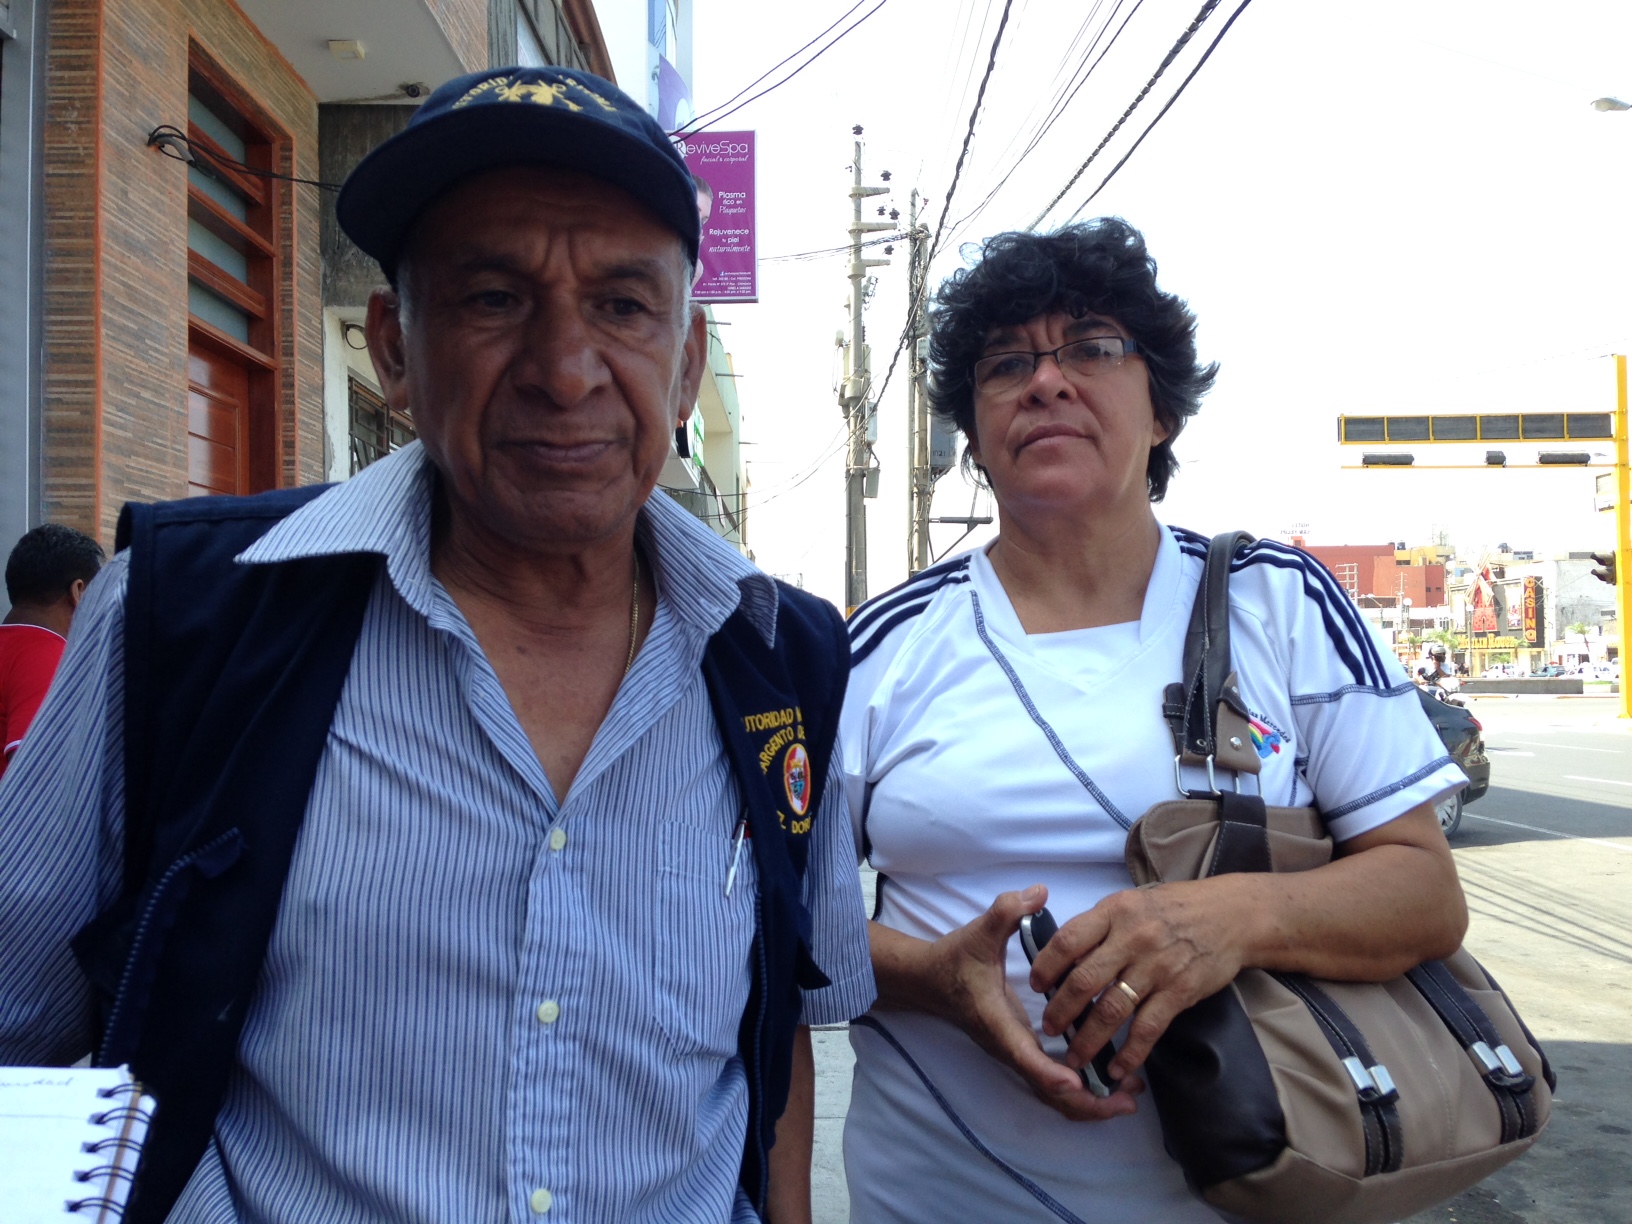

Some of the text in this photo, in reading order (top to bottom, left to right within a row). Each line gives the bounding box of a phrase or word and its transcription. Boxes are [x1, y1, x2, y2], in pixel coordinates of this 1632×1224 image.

[718, 191, 746, 199] Plasma
[709, 228, 750, 236] Rejuvenece
[709, 244, 751, 253] naturalmente
[1524, 577, 1536, 641] CASINO
[1259, 713, 1291, 744] Mercedes
